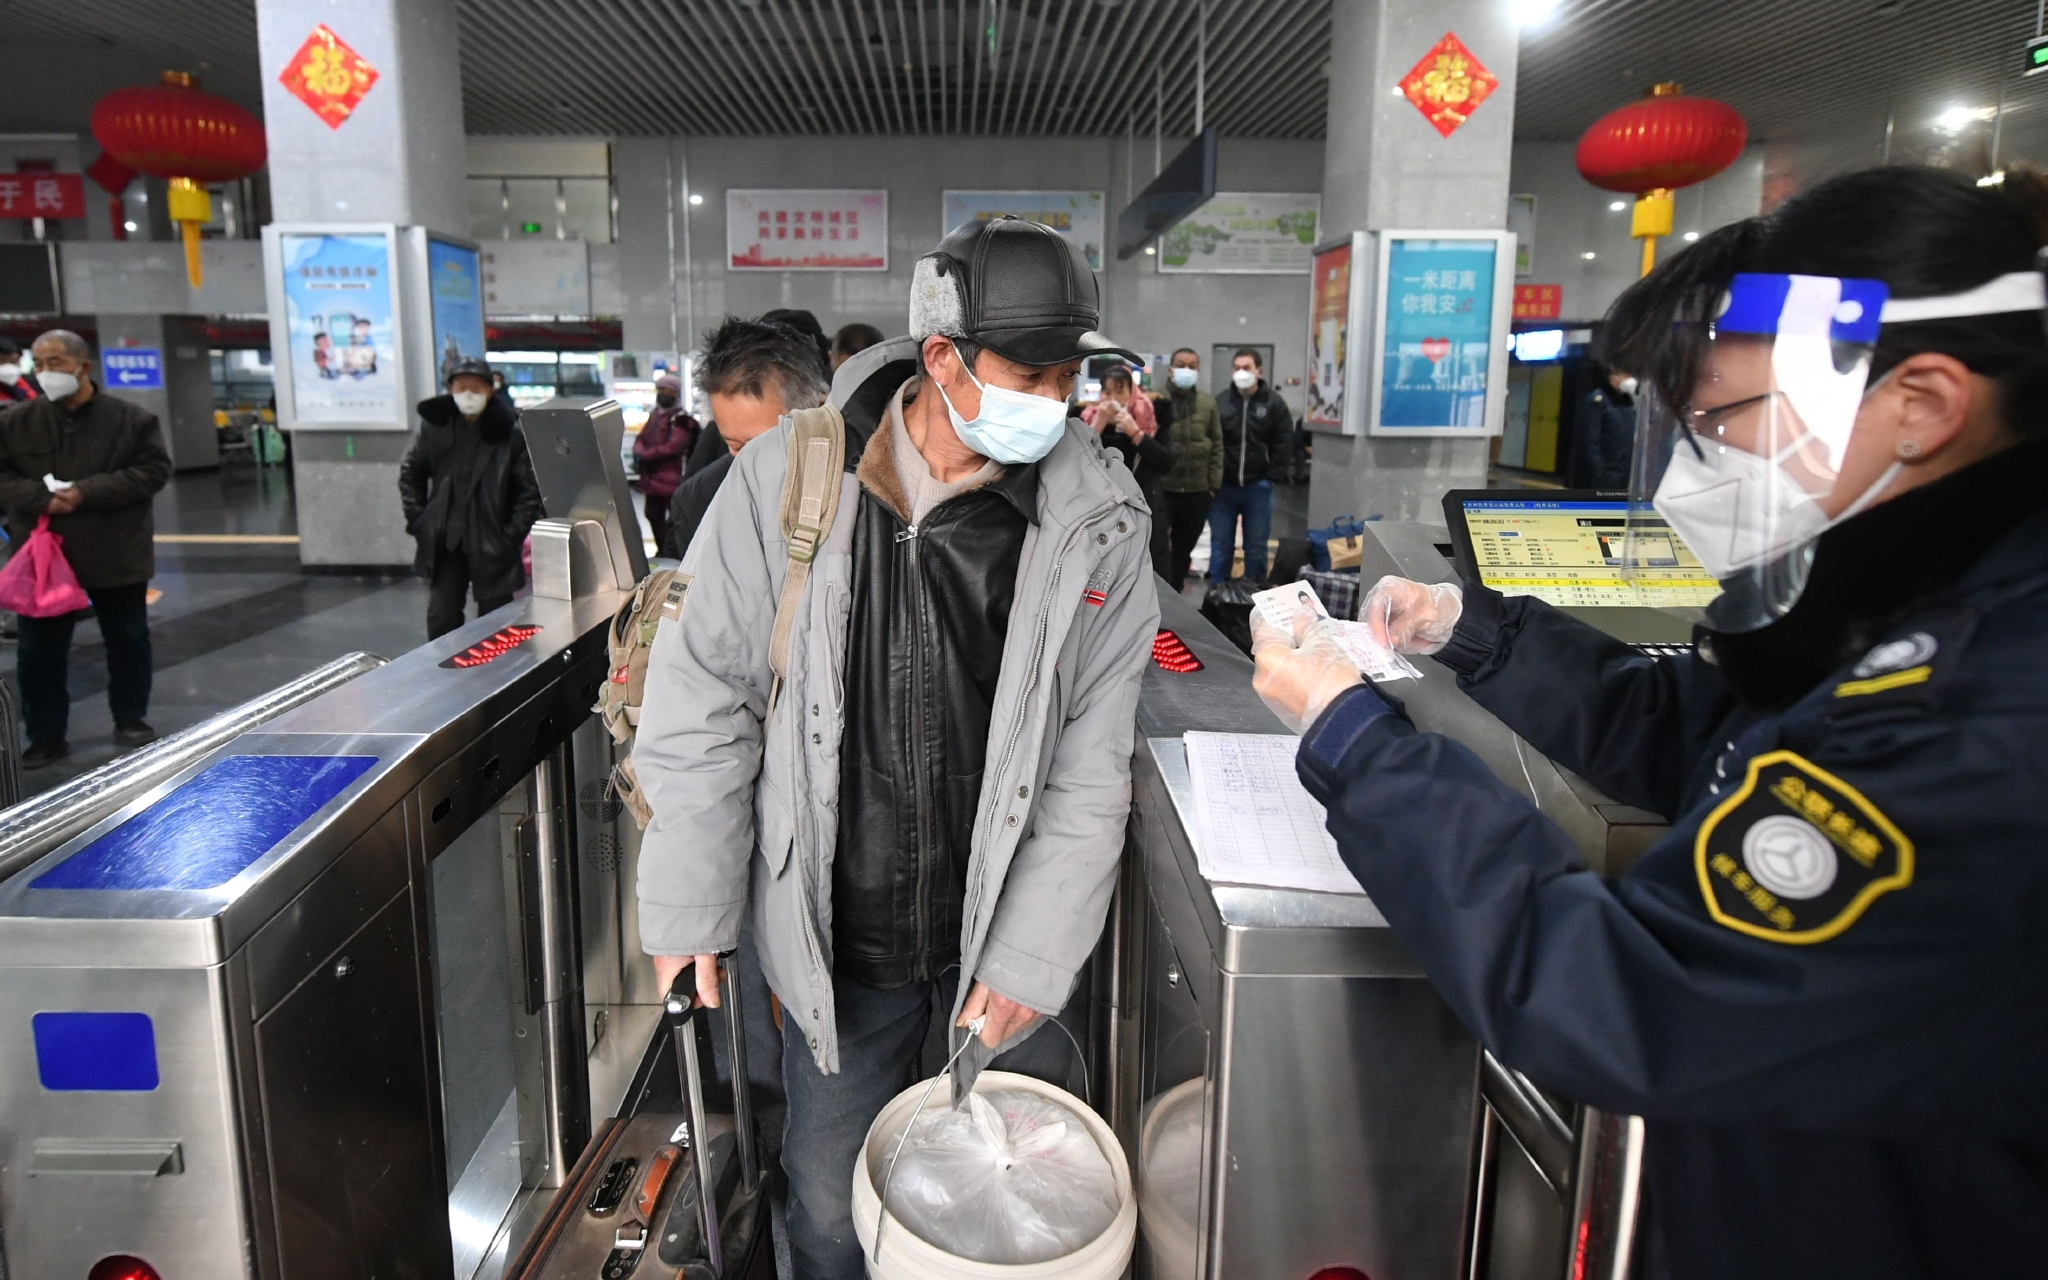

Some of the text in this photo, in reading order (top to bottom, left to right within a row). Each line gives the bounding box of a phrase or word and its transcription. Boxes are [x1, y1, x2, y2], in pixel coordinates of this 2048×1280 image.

[302, 45, 351, 95] 福
[1424, 54, 1471, 103] 福
[758, 211, 859, 224] 共建文明城区
[758, 227, 859, 240] 共享美好生活
[1404, 270, 1476, 290] 一米距离
[1513, 289, 1553, 301] 车区
[1512, 304, 1552, 316] 候车区
